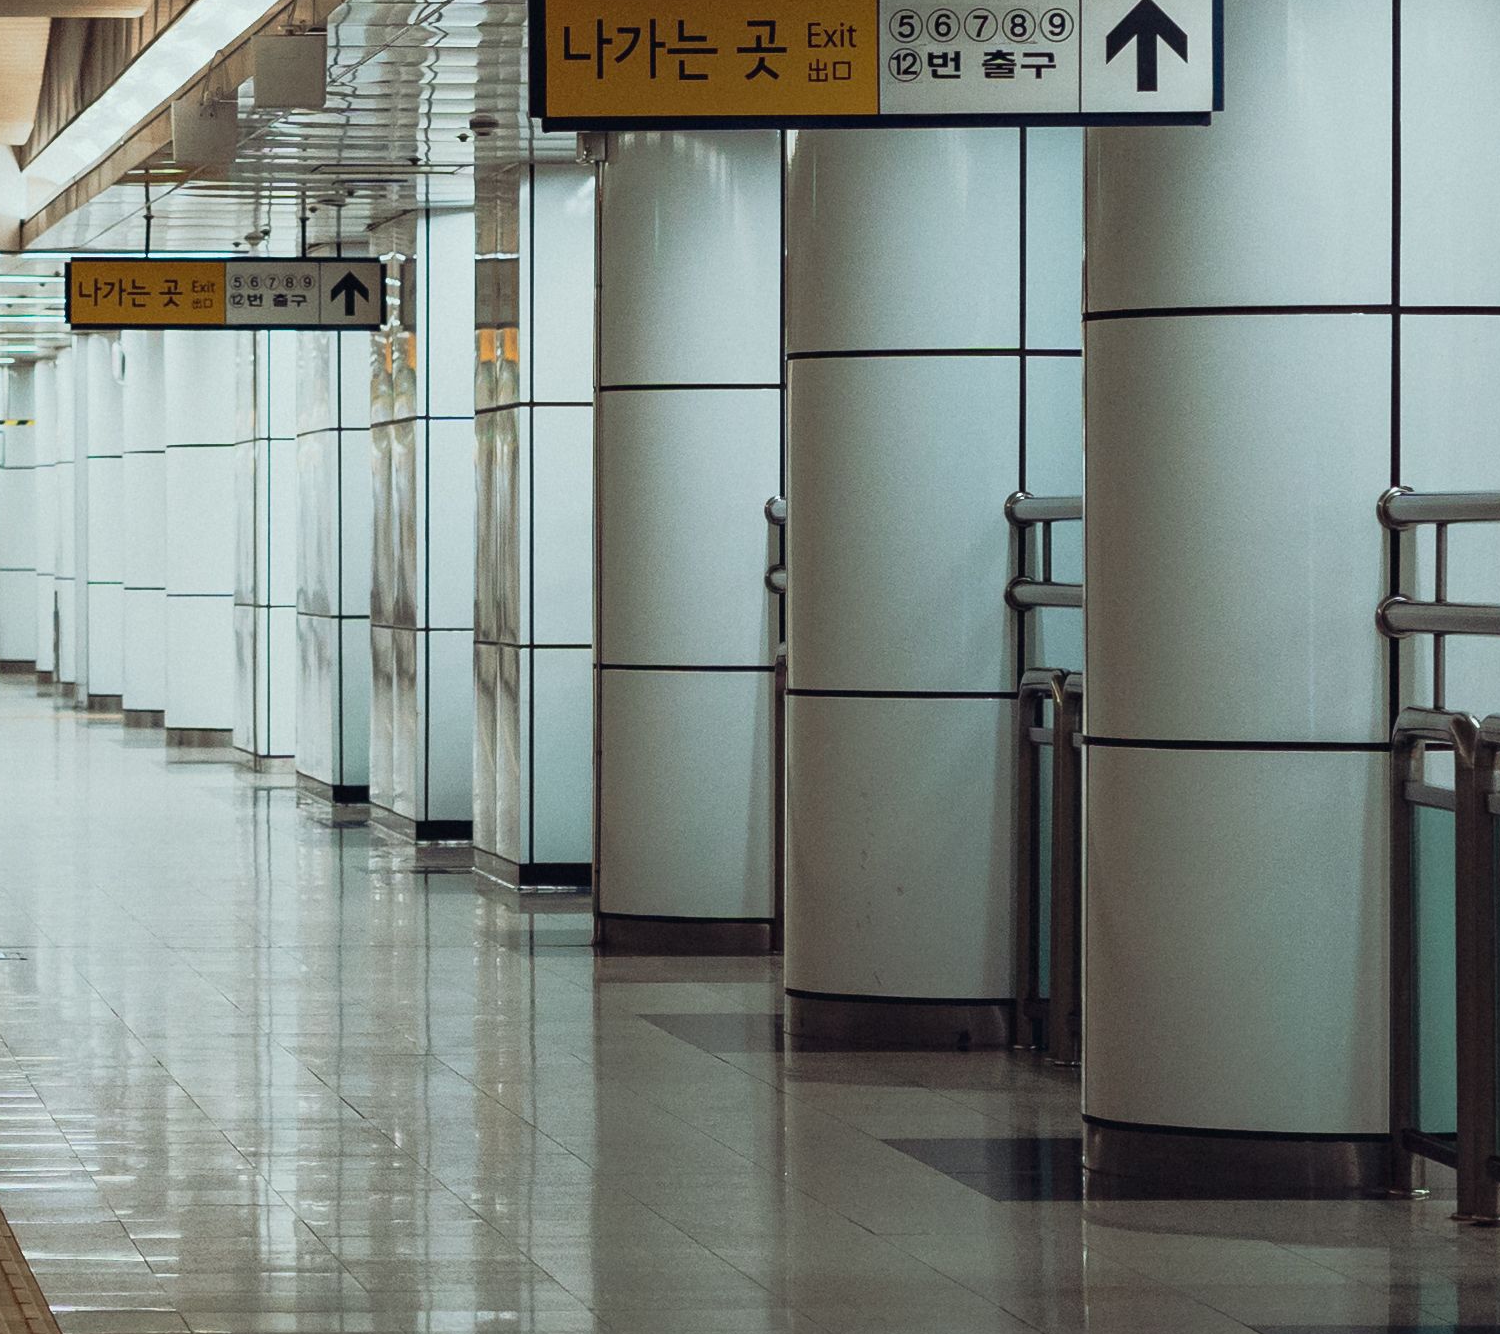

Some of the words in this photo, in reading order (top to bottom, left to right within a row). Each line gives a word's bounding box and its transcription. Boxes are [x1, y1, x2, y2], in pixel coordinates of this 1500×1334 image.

[807, 22, 858, 50] Exit
[561, 17, 719, 82] 나가는
[736, 19, 789, 82] 곳
[807, 60, 854, 84] 出口
[981, 50, 1058, 82] 출구
[77, 277, 153, 309] 나가는
[158, 278, 184, 309] 곳
[191, 279, 216, 295] Exit
[191, 297, 214, 310] 出口
[272, 293, 309, 309] 출구
